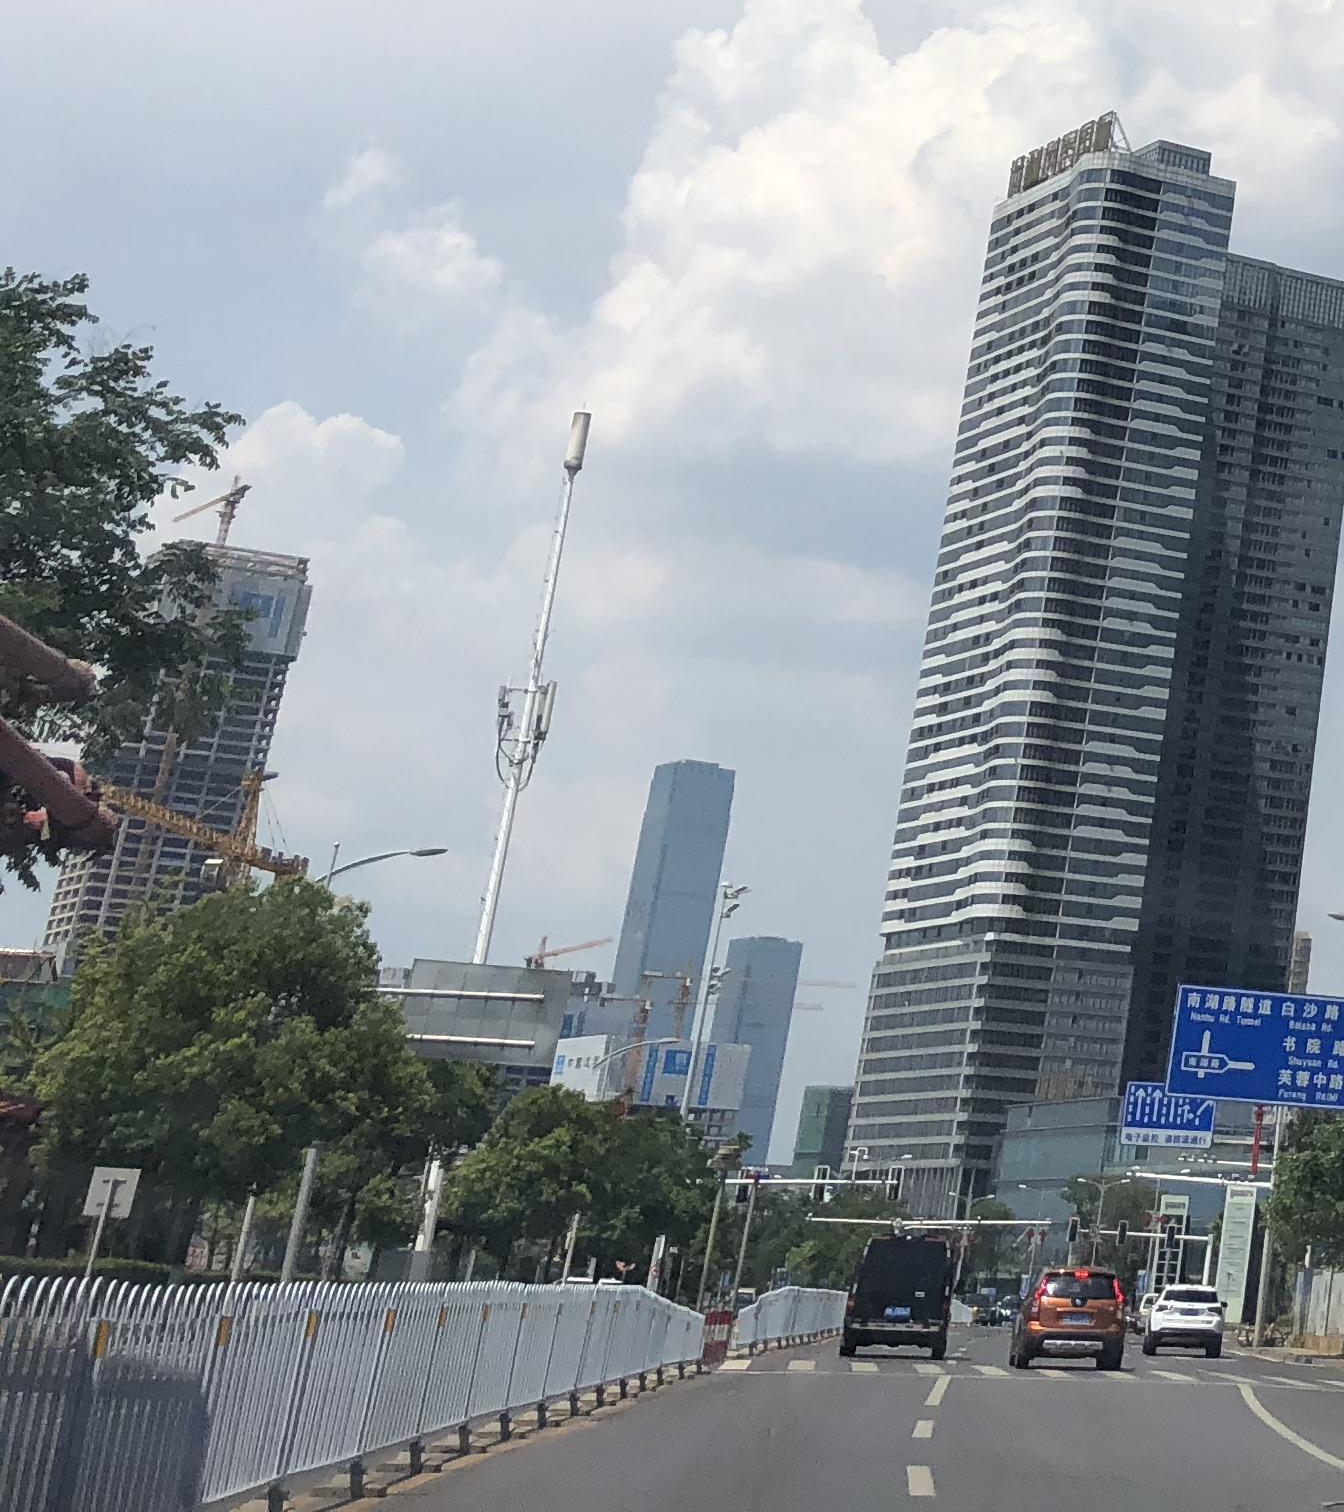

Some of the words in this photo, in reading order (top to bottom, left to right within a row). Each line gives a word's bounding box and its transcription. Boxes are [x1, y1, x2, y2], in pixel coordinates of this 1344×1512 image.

[1187, 991, 1273, 1016] 南湖路隧道
[1281, 1001, 1340, 1021] 白沙路
[1278, 1069, 1344, 1090] 芙蓉中路
